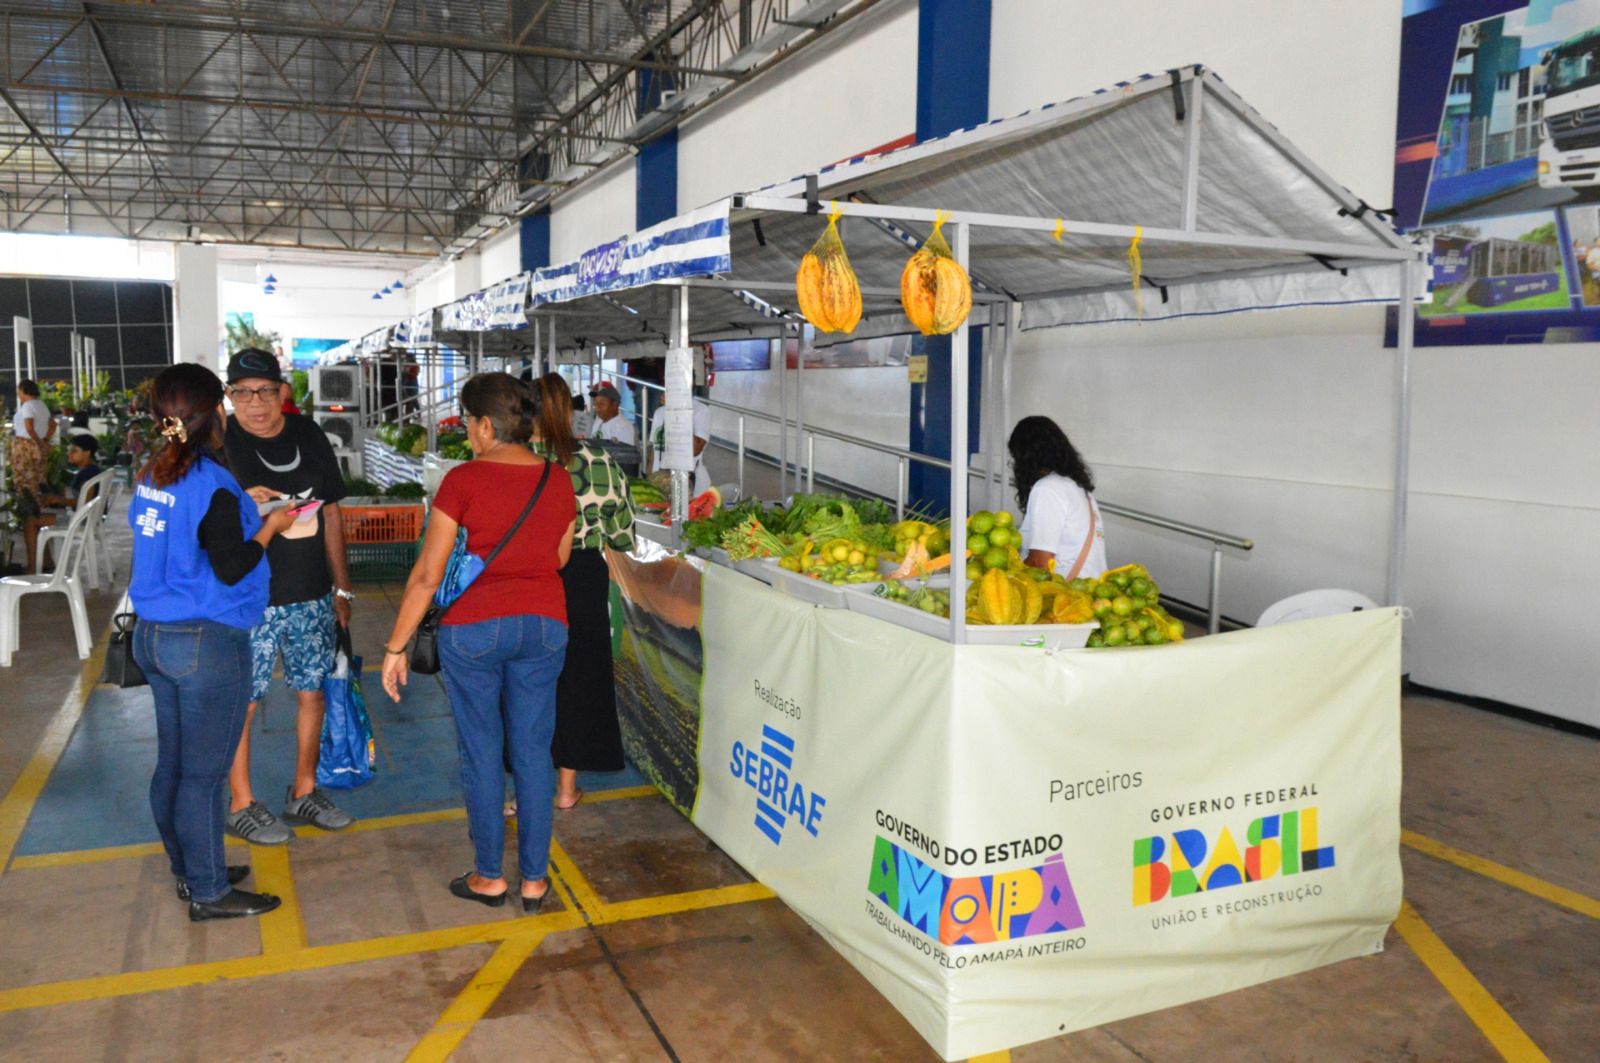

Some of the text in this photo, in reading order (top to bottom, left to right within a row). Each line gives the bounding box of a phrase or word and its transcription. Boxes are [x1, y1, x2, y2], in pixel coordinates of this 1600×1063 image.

[754, 679, 802, 720] Realização
[730, 740, 826, 838] SEBRAE
[1050, 770, 1143, 803] Parceiros
[1151, 783, 1319, 823] GOVERNO FEDERAL
[875, 809, 1063, 866] GOVERNO DO ESTADO
[1132, 806, 1335, 908] BRASIL
[867, 834, 1086, 946] AMAPÁ
[1151, 884, 1323, 930] UNIÃO E RECONSTRUÇÃO
[865, 899, 1086, 970] TRABALHANDO PELO AMAPÁ INTEIRO
